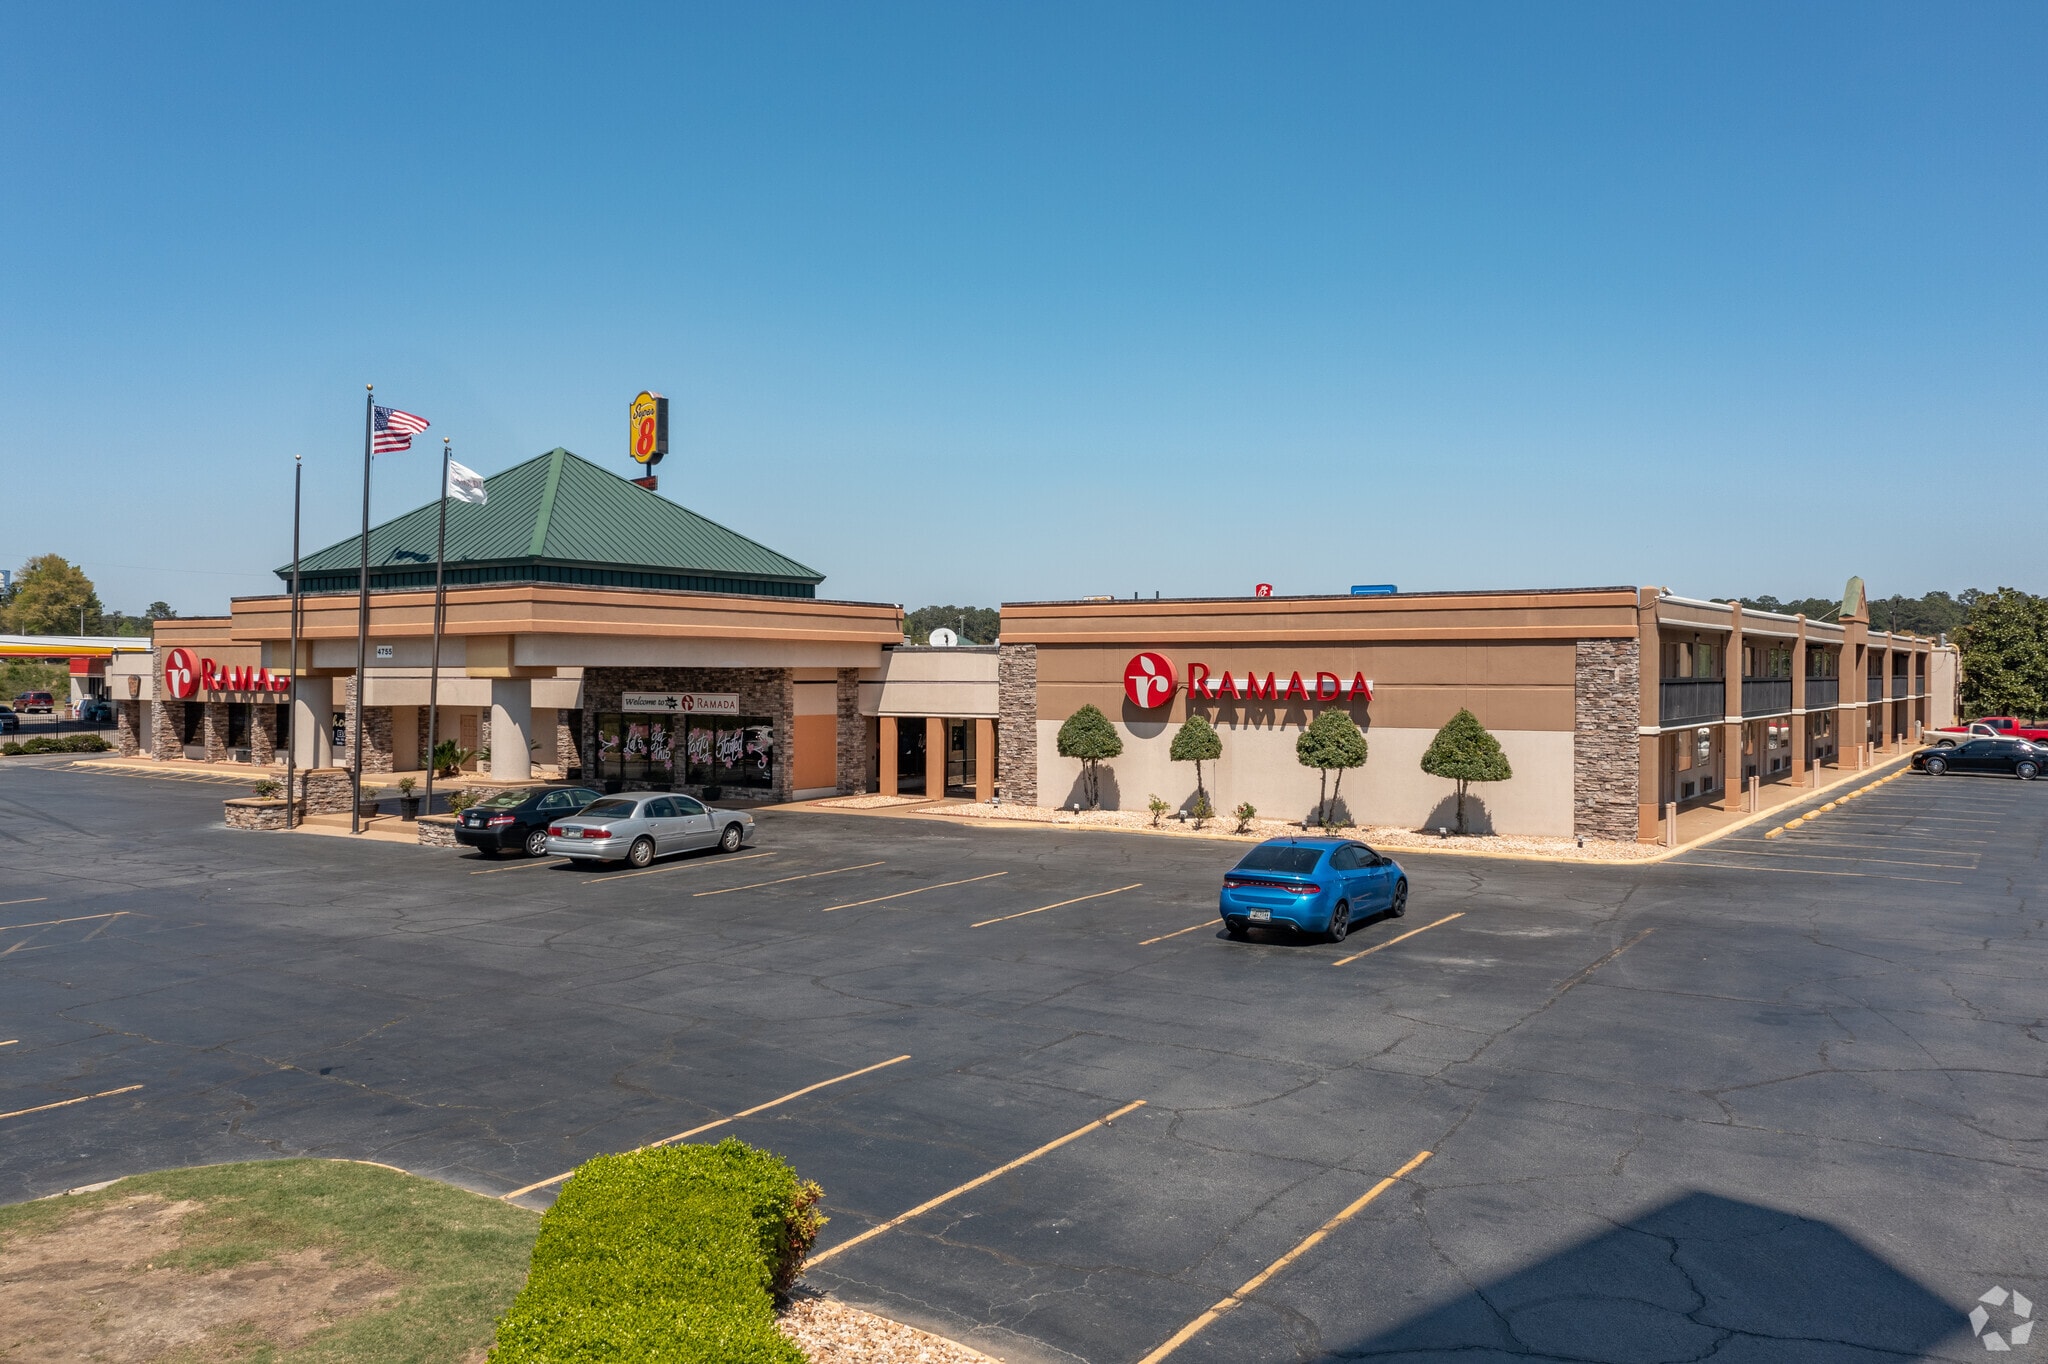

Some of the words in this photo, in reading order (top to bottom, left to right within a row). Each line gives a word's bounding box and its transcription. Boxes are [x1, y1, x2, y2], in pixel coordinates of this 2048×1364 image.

[633, 403, 655, 425] Super
[636, 417, 655, 456] 8
[377, 648, 392, 656] 4755
[201, 658, 290, 692] RAMAD
[1187, 662, 1374, 701] RAMADA
[625, 696, 656, 706] Welcome
[658, 698, 665, 706] to
[697, 698, 735, 709] RAMADA
[687, 733, 712, 762] Party
